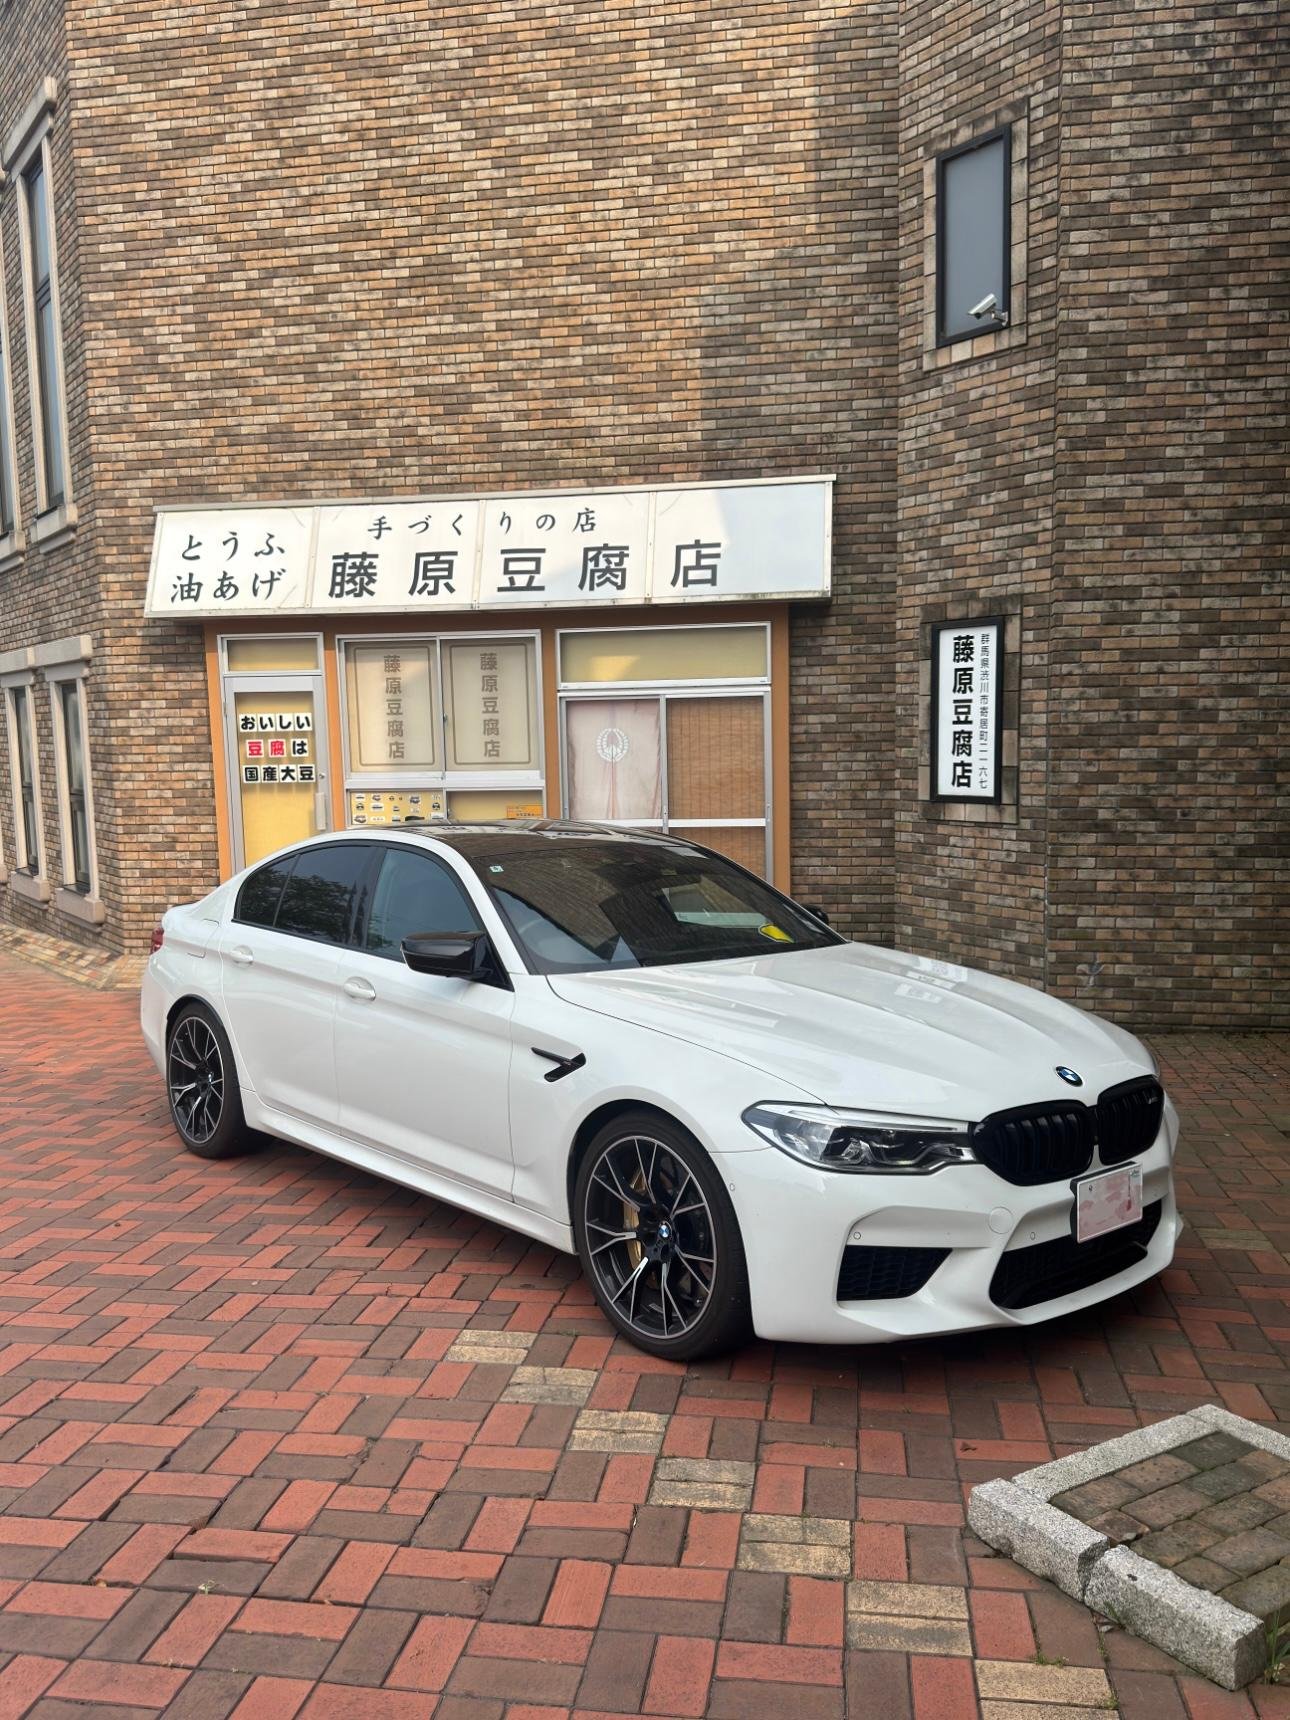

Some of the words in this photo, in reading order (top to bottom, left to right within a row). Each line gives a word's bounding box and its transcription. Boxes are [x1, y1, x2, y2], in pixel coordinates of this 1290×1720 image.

[367, 507, 597, 540] 手づくりの店
[181, 531, 285, 561] とうふ
[170, 568, 286, 603] 油あげ
[328, 539, 722, 598] 藤原豆腐店
[383, 654, 405, 759] 藤原豆腐店
[480, 652, 500, 758] 藤原豆腐店
[951, 634, 975, 788] 藤原豆腐店
[240, 715, 311, 730] おいしい
[247, 740, 307, 756] 豆腐は
[244, 766, 314, 781] 国産大豆
